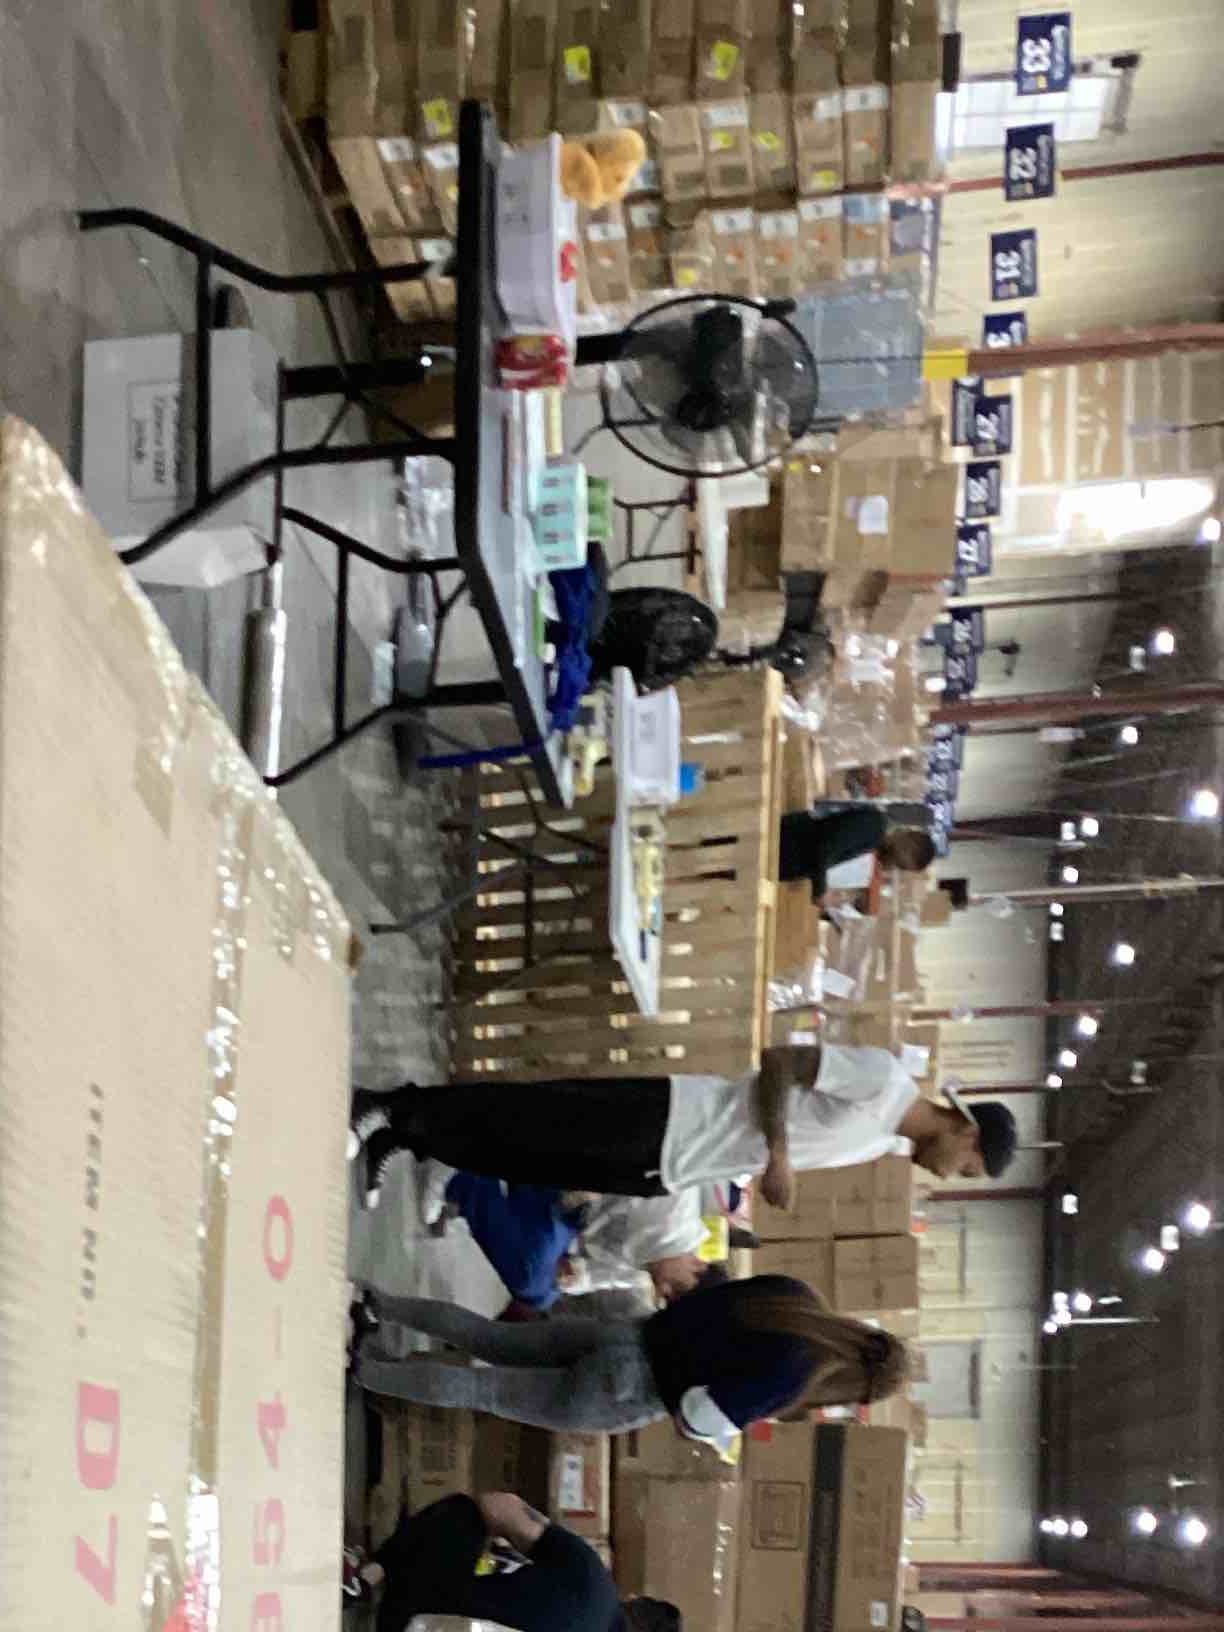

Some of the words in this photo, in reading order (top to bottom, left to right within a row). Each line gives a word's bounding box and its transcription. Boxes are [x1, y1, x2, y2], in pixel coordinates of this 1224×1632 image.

[1021, 38, 1052, 73] 33
[1009, 147, 1038, 181] 32
[995, 250, 1021, 281] 31
